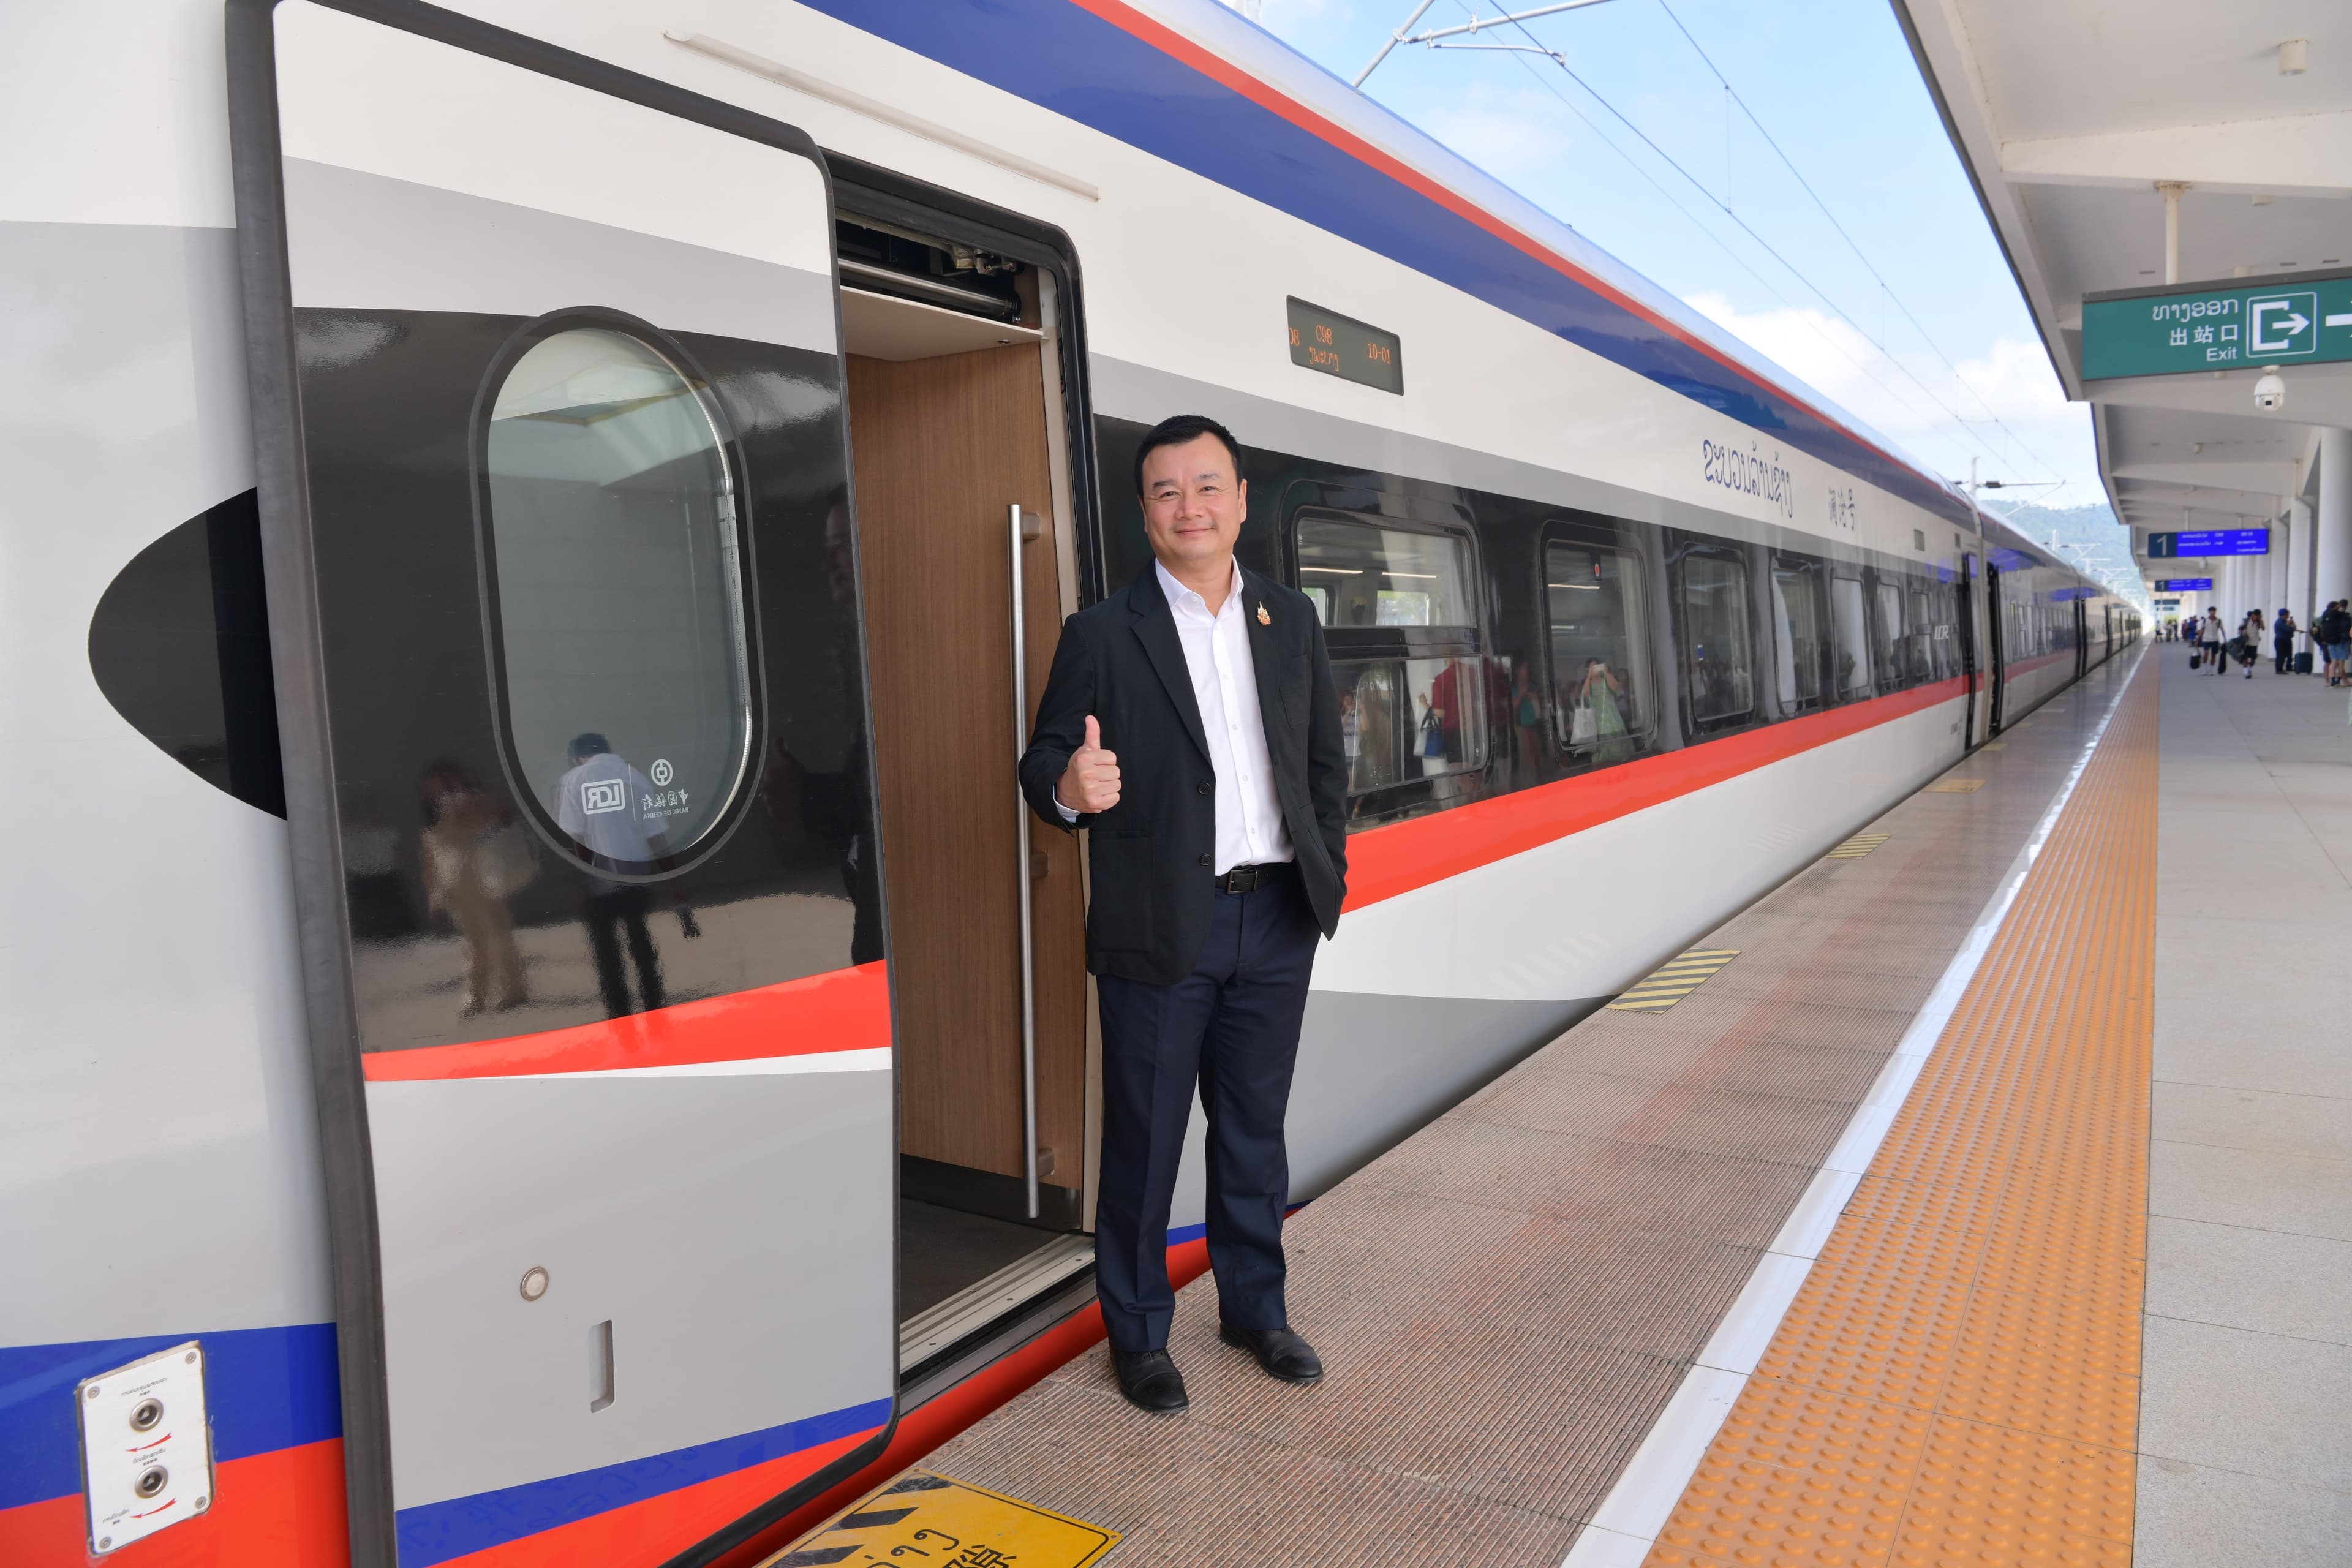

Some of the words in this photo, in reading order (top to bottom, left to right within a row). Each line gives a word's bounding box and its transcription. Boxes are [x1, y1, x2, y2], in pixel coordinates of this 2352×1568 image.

[1316, 325, 1332, 345] C98
[2169, 324, 2238, 347] 出站口
[1368, 342, 1391, 364] 10-01
[2206, 346, 2237, 361] Exit
[2157, 535, 2167, 556] 1
